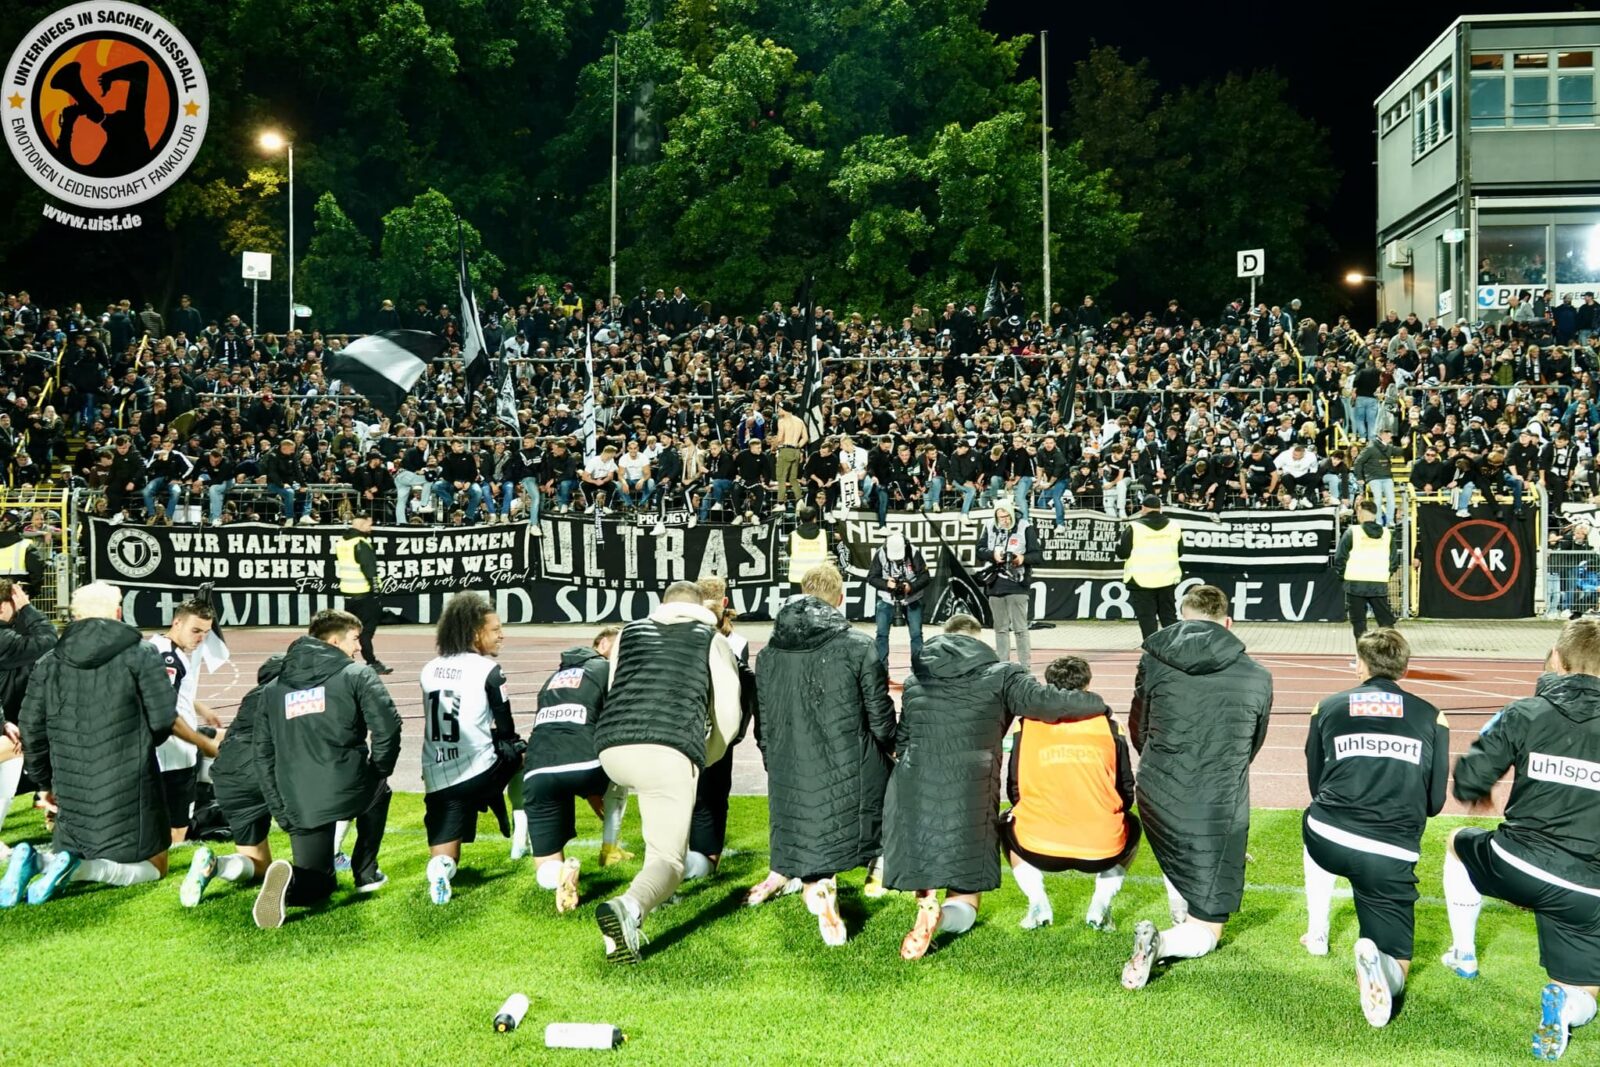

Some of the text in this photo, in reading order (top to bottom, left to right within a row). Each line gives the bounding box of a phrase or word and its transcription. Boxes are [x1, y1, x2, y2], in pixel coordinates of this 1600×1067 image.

[1243, 254, 1258, 272] D
[1076, 519, 1091, 530] IST
[1232, 522, 1271, 531] nero
[168, 532, 220, 553] WIR
[227, 533, 322, 555] HALTEN
[395, 531, 516, 556] ZUSAMMEN
[1045, 539, 1080, 550] MINUTEN
[1084, 541, 1097, 551] AM
[1093, 531, 1116, 542] LANG
[1181, 530, 1319, 549] constante
[541, 519, 769, 580] ULTRAS
[1056, 551, 1072, 561] DEN
[1450, 546, 1507, 572] VAR
[174, 557, 229, 578] UND
[238, 559, 325, 579] GEHEN
[461, 553, 514, 574] WEG
[295, 577, 327, 593] Für
[434, 576, 456, 588] vor
[459, 574, 483, 588] den
[434, 667, 462, 680] NELSON
[428, 689, 461, 743] 13
[1338, 736, 1418, 757] uhlsport
